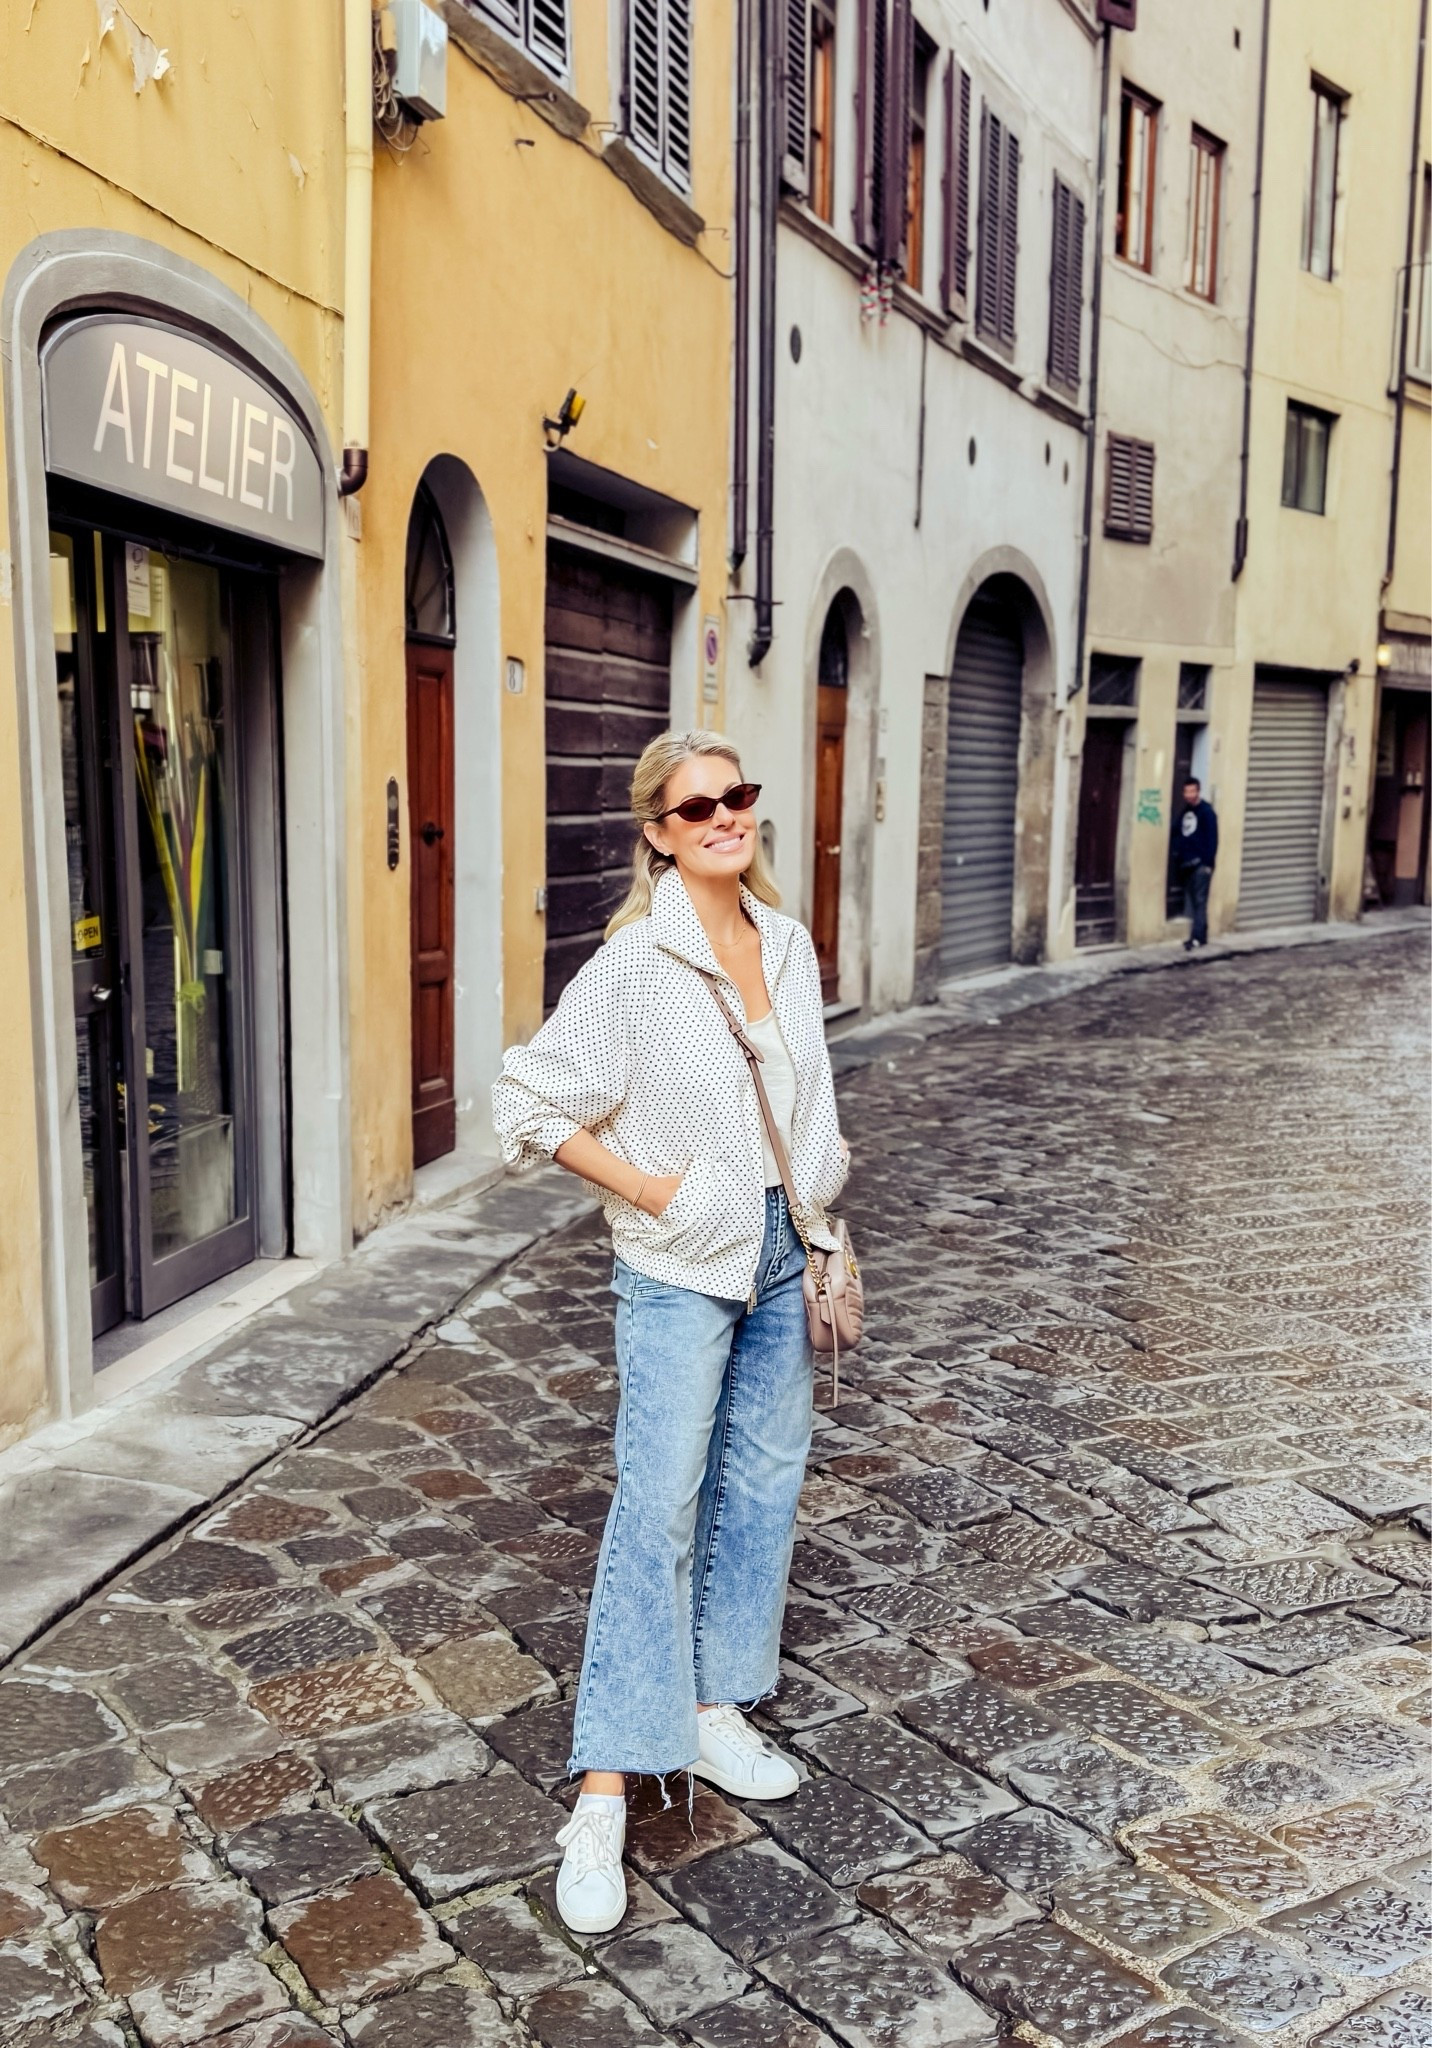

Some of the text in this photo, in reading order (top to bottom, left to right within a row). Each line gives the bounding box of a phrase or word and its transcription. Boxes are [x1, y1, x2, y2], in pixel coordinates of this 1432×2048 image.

[93, 342, 296, 521] ATELIER
[508, 662, 517, 691] 8
[77, 926, 99, 941] OPEN
